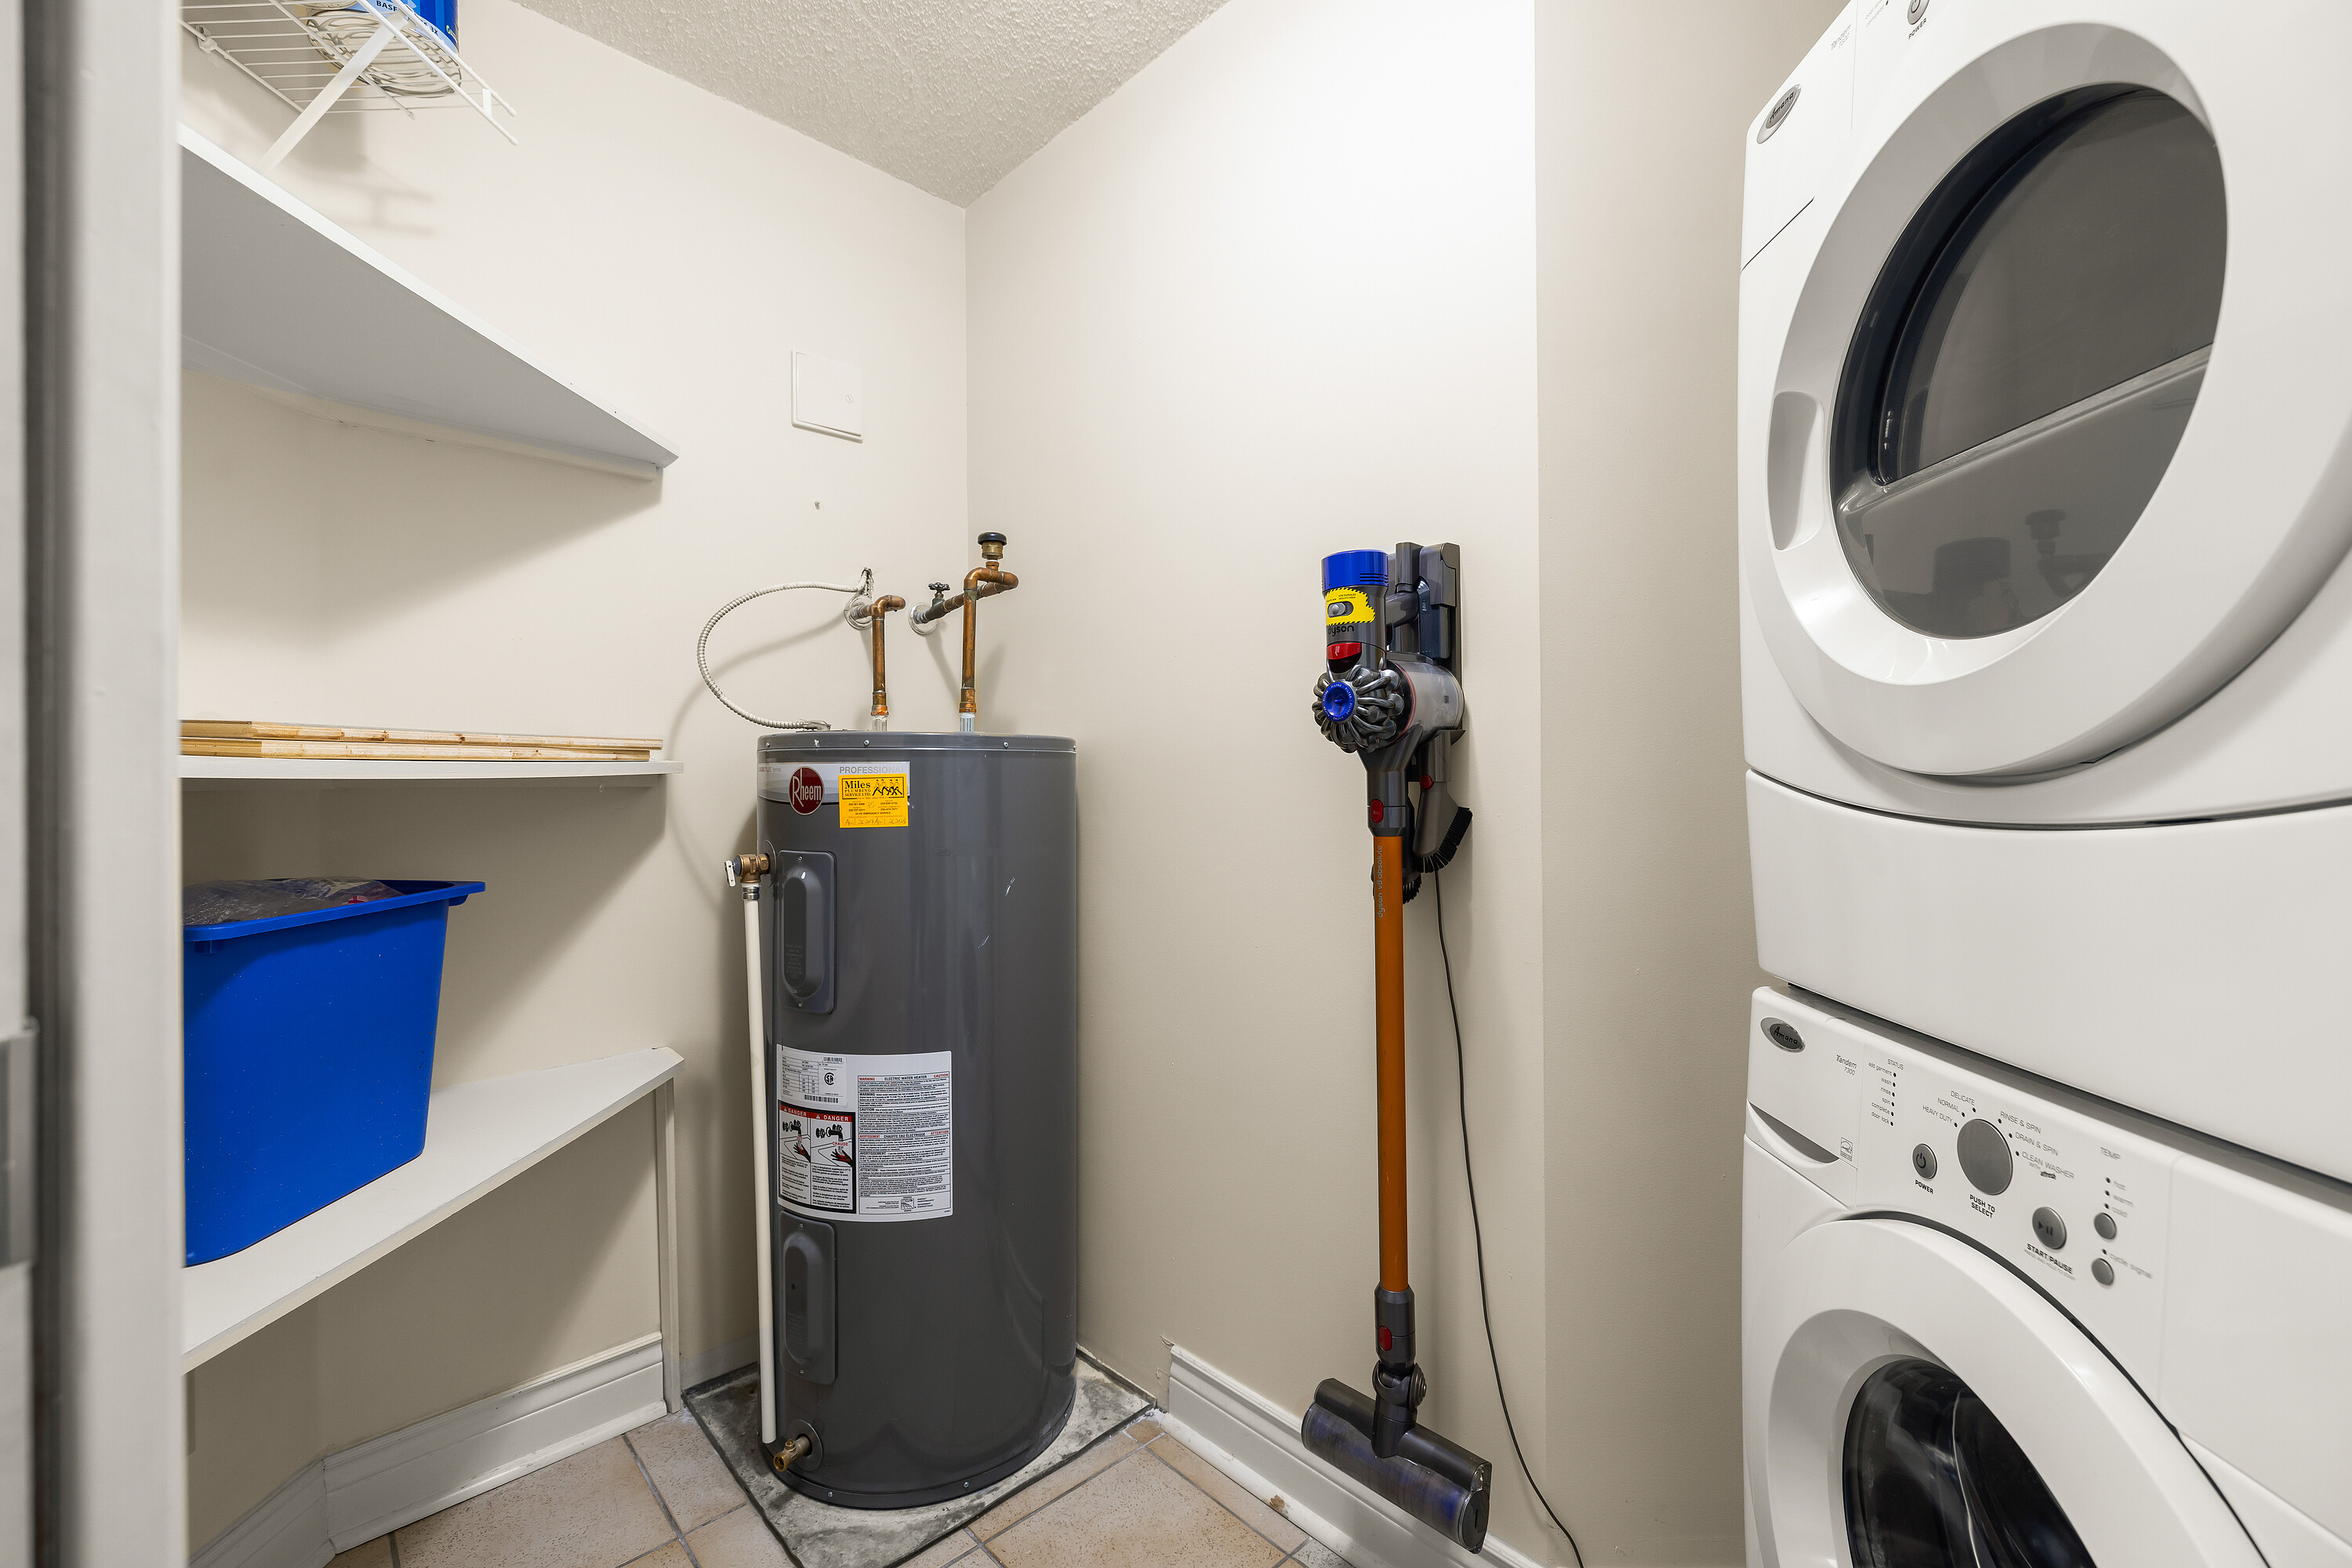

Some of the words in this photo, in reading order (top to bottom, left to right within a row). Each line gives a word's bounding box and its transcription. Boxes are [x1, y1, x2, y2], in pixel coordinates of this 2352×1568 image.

[376, 1, 398, 12] BASE
[1908, 18, 1927, 40] POWER
[1769, 91, 1794, 123] Amana
[792, 769, 821, 807] Rheem
[845, 781, 871, 789] Miles
[1377, 893, 1385, 918] dyson
[1773, 1026, 1798, 1044] Amana
[1836, 1054, 1857, 1069] Tandem
[1887, 1059, 1904, 1070] STATUS
[1844, 1066, 1855, 1075] 7300
[1876, 1066, 1892, 1076] garment
[1881, 1078, 1892, 1086] wash
[1881, 1087, 1891, 1095] rinse
[1951, 1090, 1975, 1106] DELICATE
[1871, 1102, 1890, 1114] complete
[1882, 1097, 1891, 1105] spin
[1938, 1098, 1959, 1113] NORMAL
[788, 1108, 807, 1117] DANGER
[1923, 1105, 1939, 1117] HEAVY
[1939, 1112, 1953, 1123] DUTY
[2000, 1111, 2018, 1124] RINSE
[2026, 1122, 2041, 1134] SPIN
[2015, 1132, 2034, 1146] DRAIN
[2043, 1144, 2058, 1156] SPIN
[2100, 1147, 2121, 1160] TEMP
[2022, 1151, 2043, 1166] CLEAN
[2045, 1161, 2074, 1179] WASHER
[1915, 1179, 1934, 1194] POWER
[1970, 1194, 1986, 1208] PUSH
[1987, 1203, 1995, 1213] TO
[1971, 1202, 1993, 1218] SELECT
